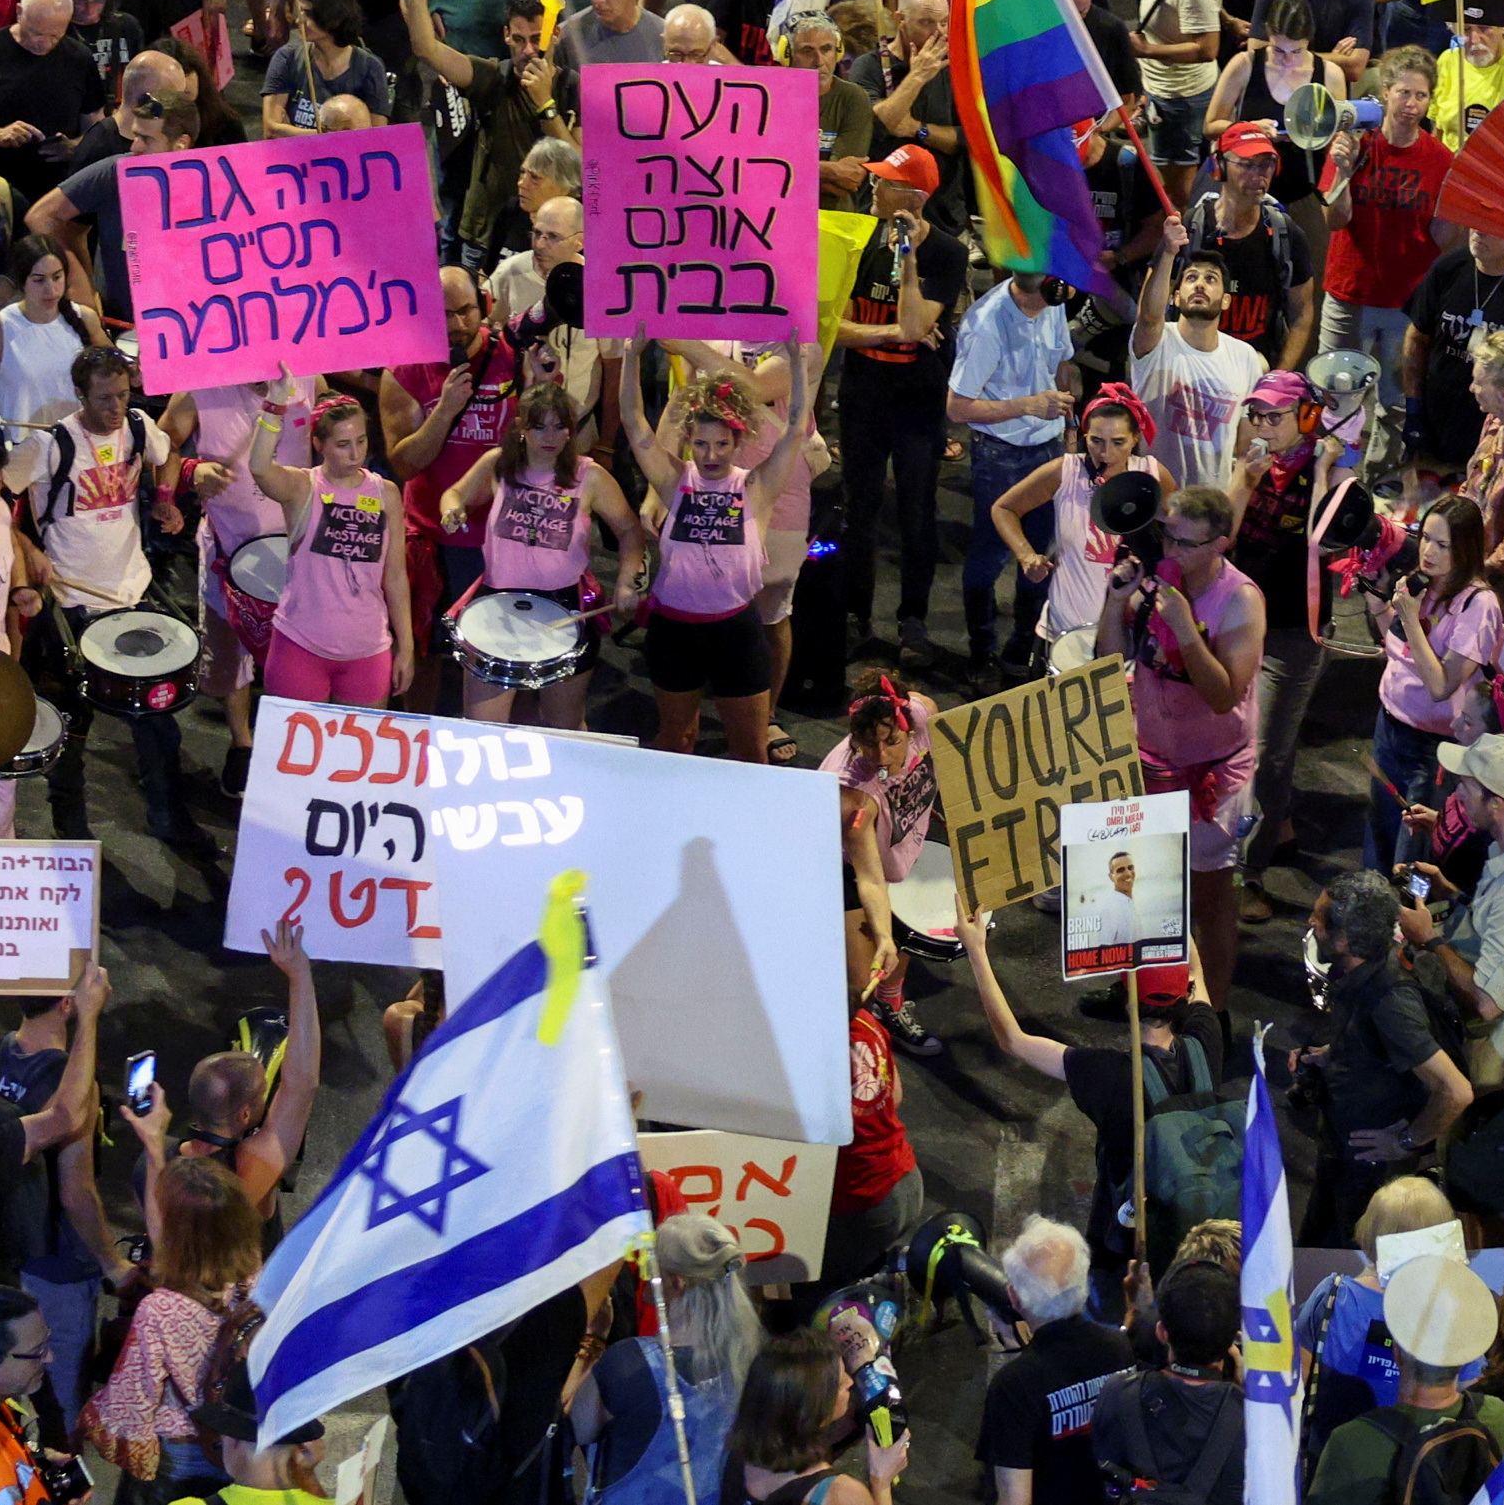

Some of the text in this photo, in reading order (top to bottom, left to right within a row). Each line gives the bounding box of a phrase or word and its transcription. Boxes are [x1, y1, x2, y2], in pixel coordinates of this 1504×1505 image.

[615, 78, 771, 141] העם
[637, 154, 793, 198] רוצה
[126, 154, 255, 232] גבר
[624, 204, 777, 251] אותם
[201, 217, 342, 286] תסיים
[606, 260, 789, 315] בבית
[506, 509, 568, 533] HOSTAGE
[682, 515, 739, 528] HOSTAGE
[324, 528, 381, 545] HOSTAGE
[690, 528, 727, 541] DEAL
[331, 543, 370, 559] DEAL
[935, 668, 1133, 813] YOU'RE
[305, 796, 426, 862] היום
[1106, 812, 1145, 826] OMRI MIRAN
[46, 881, 82, 904] לקח
[1066, 916, 1102, 935] BRING
[1067, 934, 1089, 950] HIM
[1067, 949, 1099, 968] HOME
